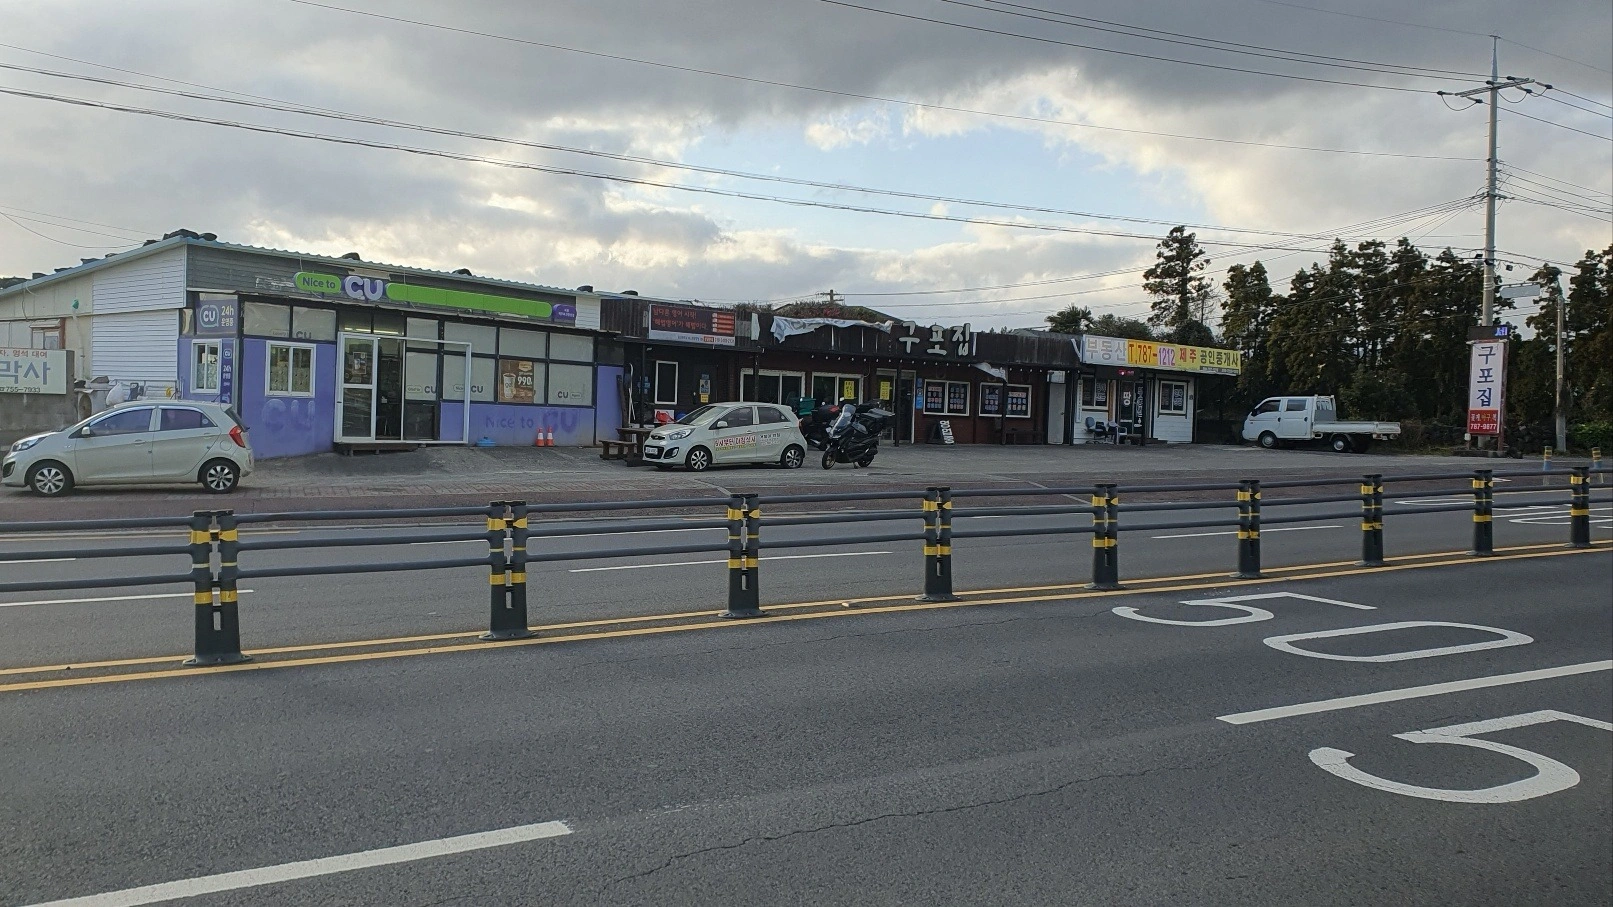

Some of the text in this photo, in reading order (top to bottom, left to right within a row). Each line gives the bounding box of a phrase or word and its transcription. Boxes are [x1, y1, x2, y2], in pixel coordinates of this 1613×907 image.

[302, 277, 324, 288] Nice
[326, 280, 336, 289] to
[344, 275, 384, 301] CU
[203, 310, 216, 322] CU
[221, 304, 234, 316] 24h
[899, 320, 971, 356] 구포집
[1086, 338, 1126, 361] 부동산
[1200, 350, 1239, 367] 공인중개사
[424, 385, 437, 394] CU
[471, 385, 484, 393] CU
[1477, 346, 1496, 407] 구포집
[557, 390, 569, 398] CU
[1112, 591, 1534, 663] 50
[1308, 709, 1613, 804] 5
